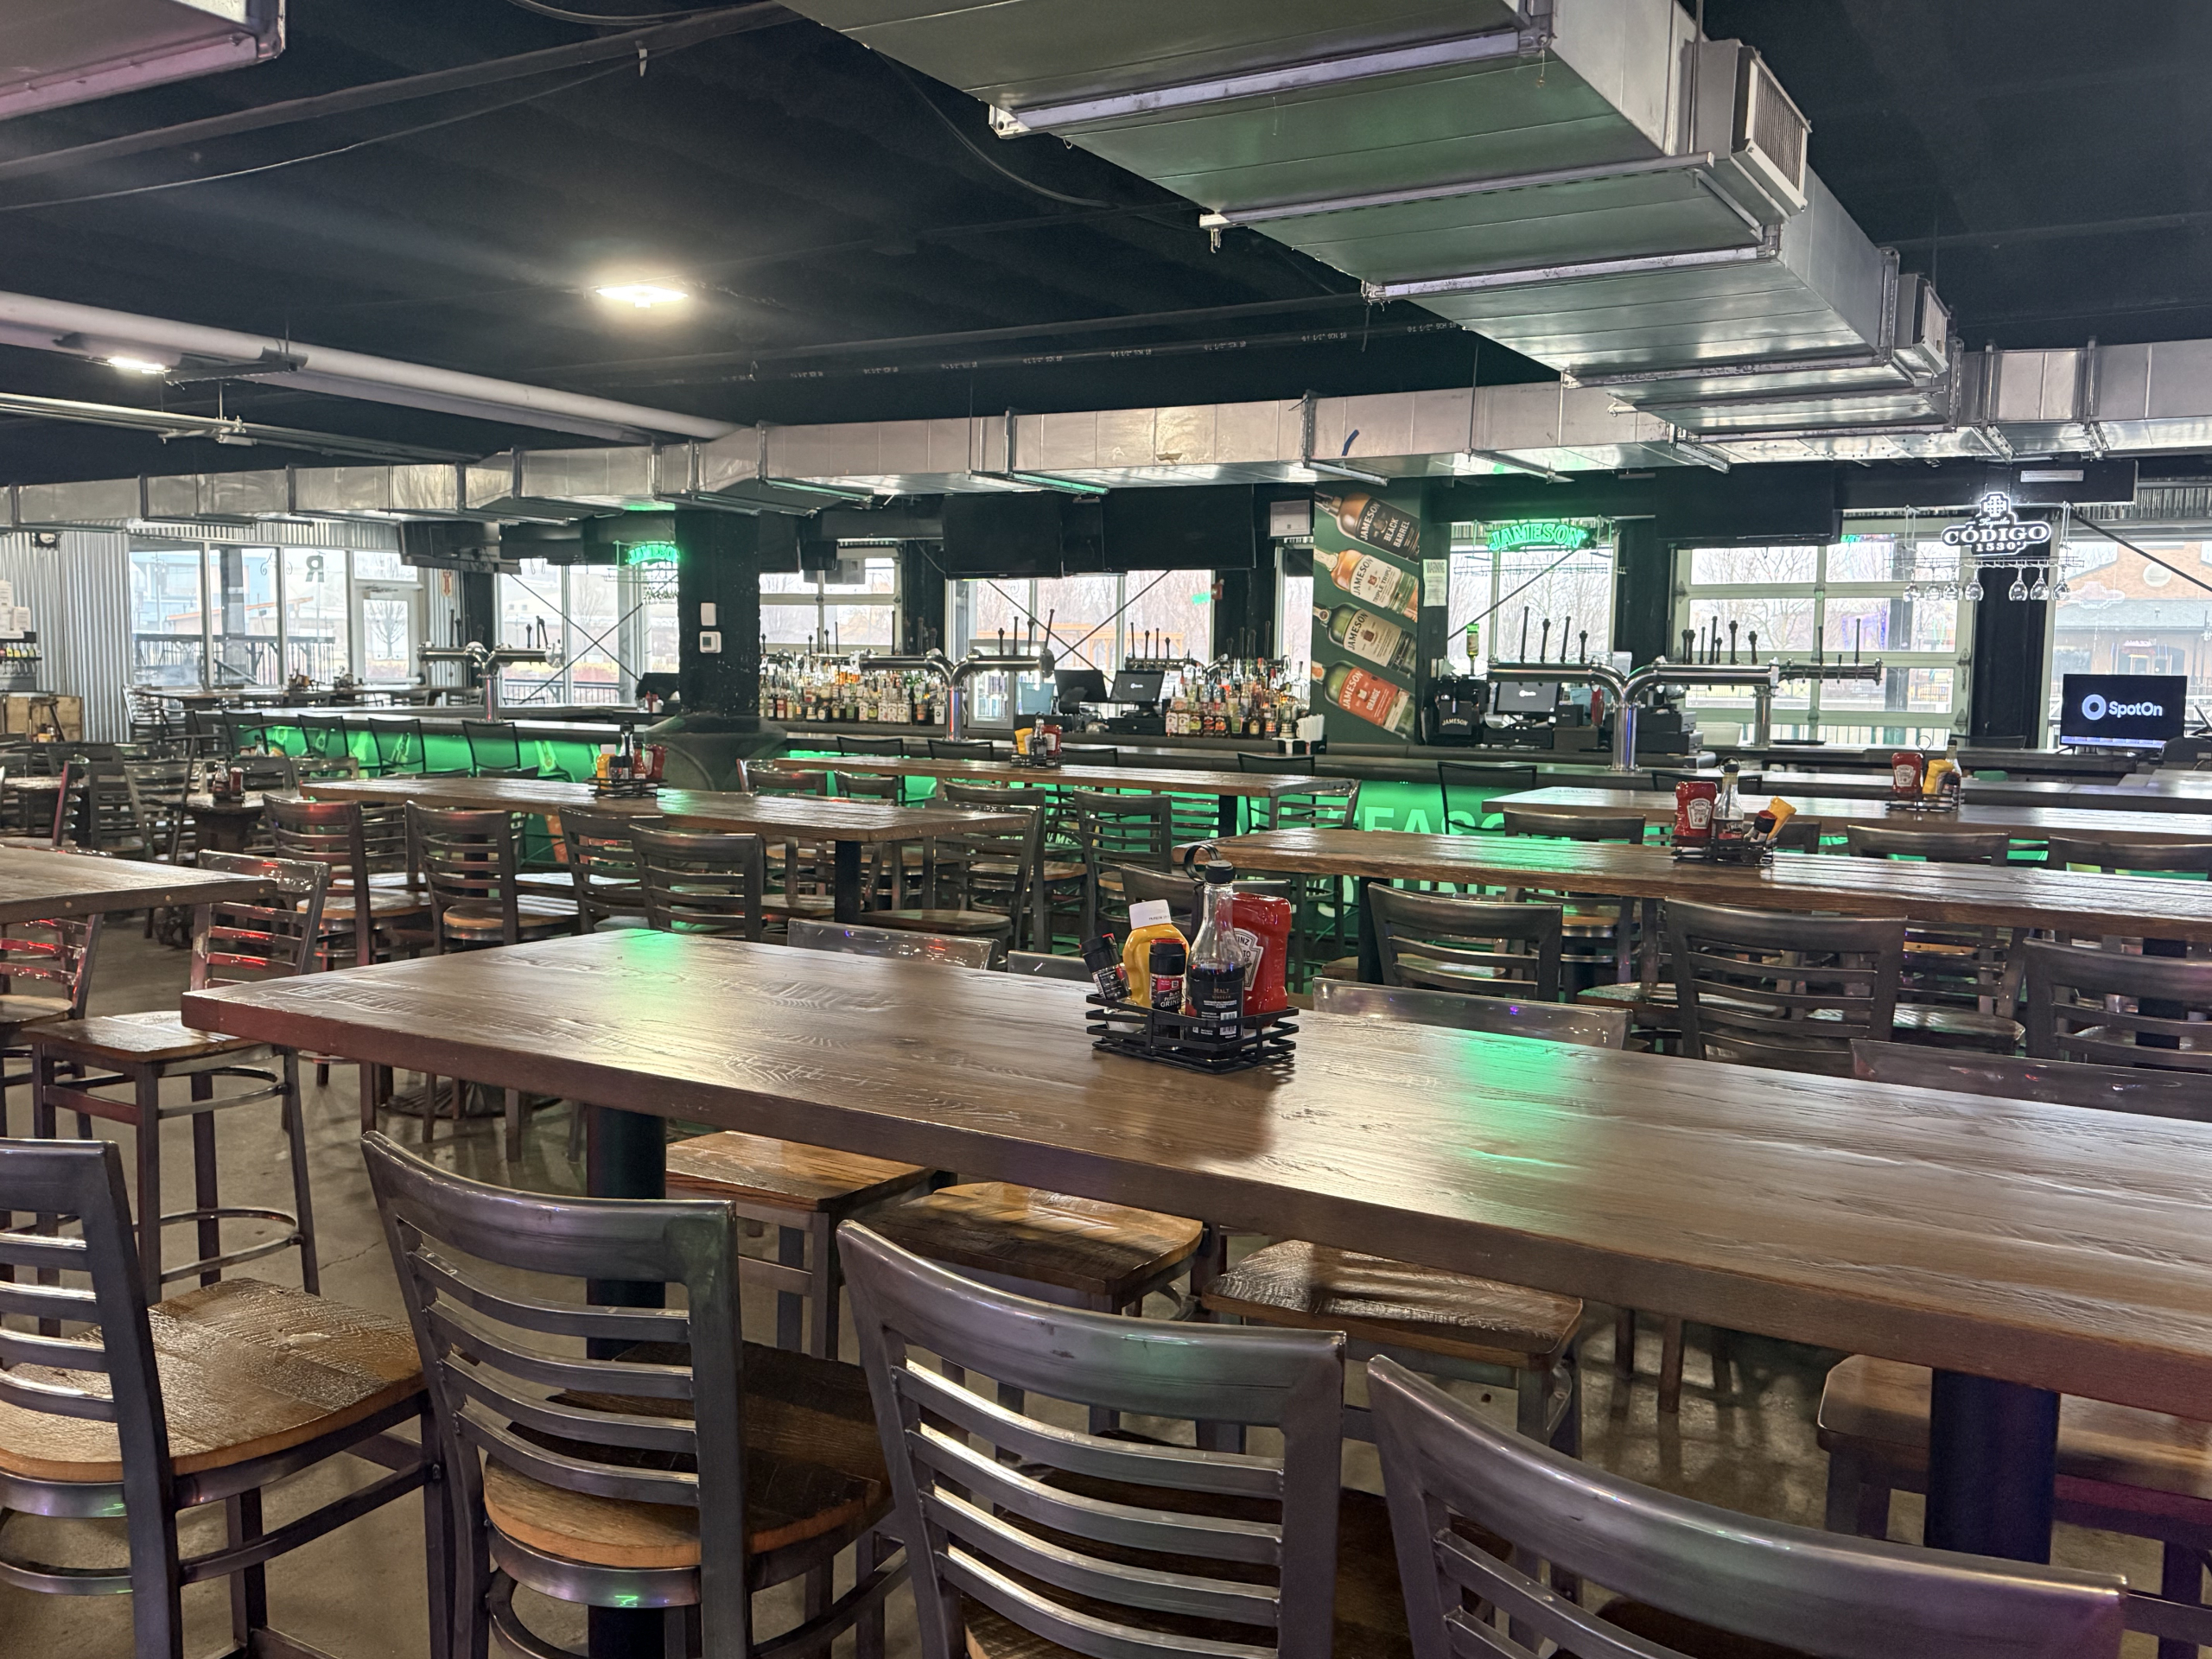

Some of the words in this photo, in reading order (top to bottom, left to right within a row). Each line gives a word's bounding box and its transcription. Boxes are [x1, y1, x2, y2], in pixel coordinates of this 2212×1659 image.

[1360, 501, 1381, 541] JAMESON
[1383, 517, 1399, 543] BLACK
[1393, 521, 1410, 548] BARREL
[1944, 525, 2048, 544] CÓDIGO
[1978, 517, 2011, 530] Tequila
[1489, 522, 1584, 551] JAMESON
[1353, 556, 1374, 595] JAMESON
[1372, 585, 1384, 603] TRIPLE
[1381, 565, 1393, 584] TRIPLE
[1347, 612, 1369, 651] JAMESON
[1343, 671, 1363, 709] JAMESON
[1366, 688, 1381, 711] ORANGE
[1441, 718, 1469, 727] JAMESON
[2108, 701, 2163, 718] SpotOn
